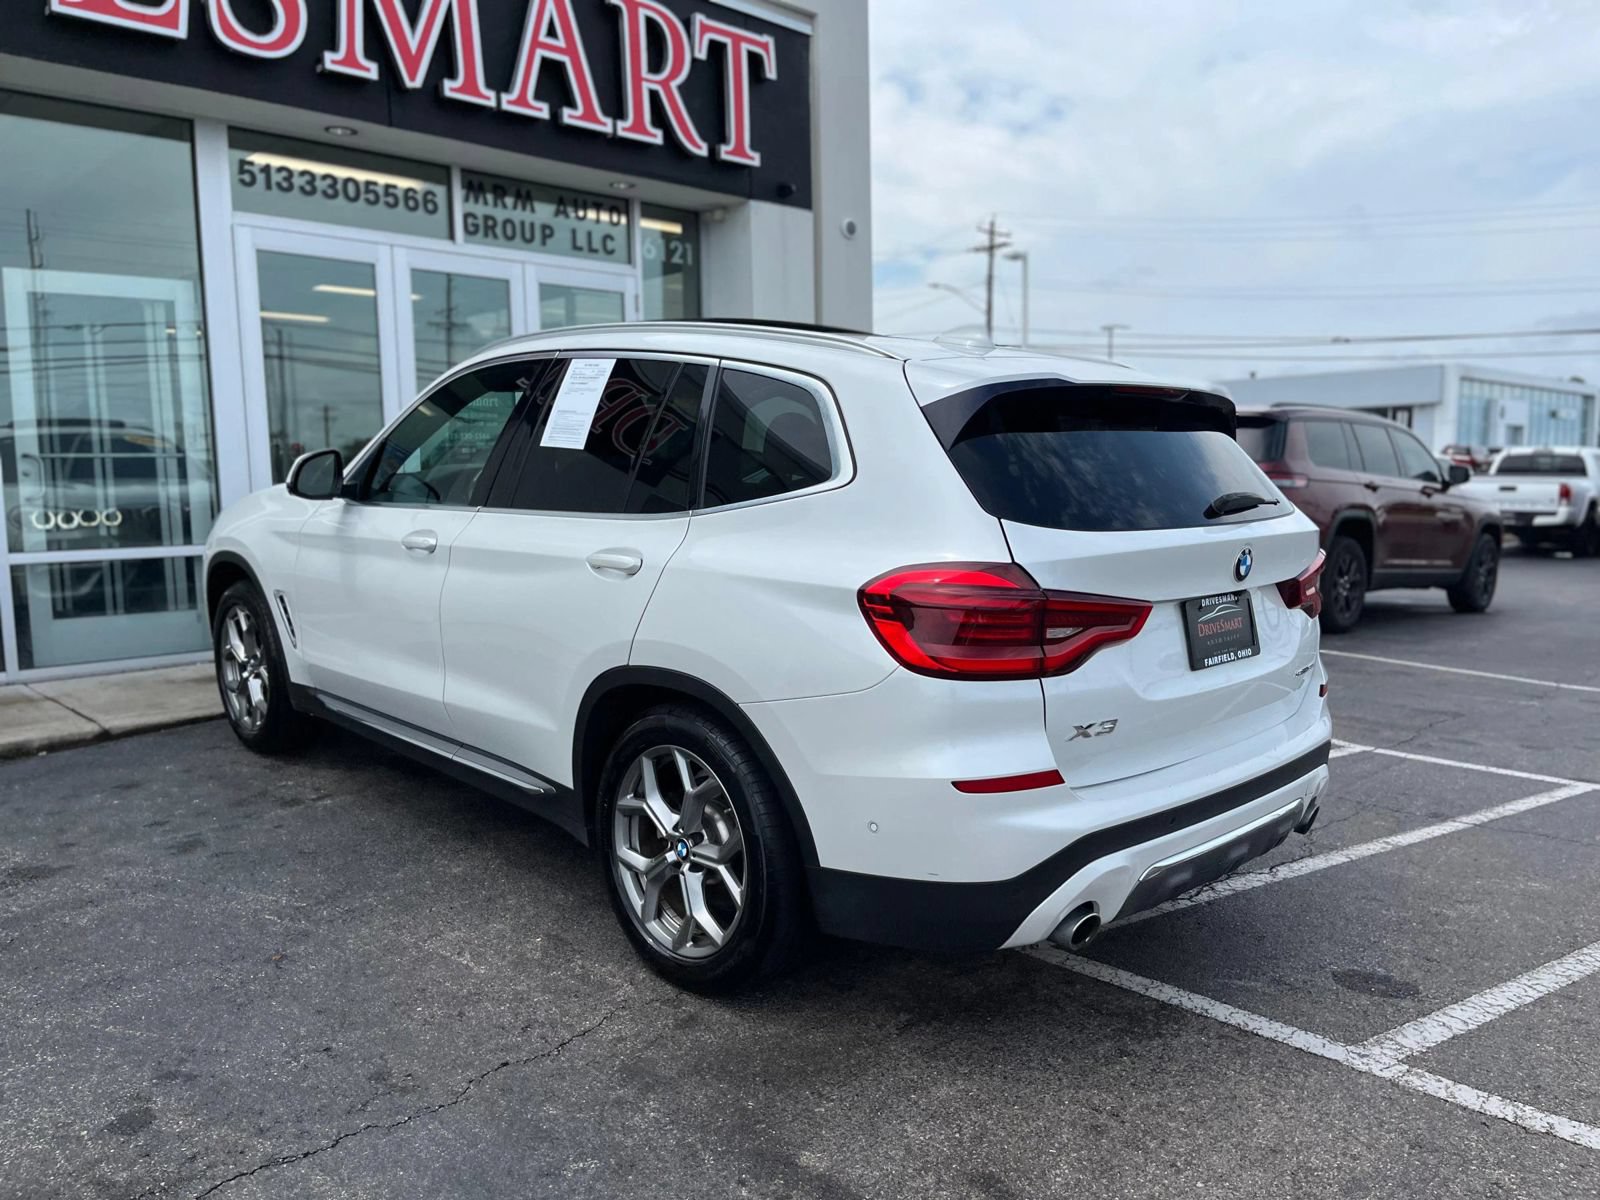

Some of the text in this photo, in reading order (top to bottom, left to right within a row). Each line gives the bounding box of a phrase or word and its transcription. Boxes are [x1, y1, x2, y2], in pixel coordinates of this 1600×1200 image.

[238, 158, 439, 215] 5133305566
[464, 180, 622, 227] MRM AUTO
[463, 212, 616, 256] GROUP LLC
[1204, 651, 1237, 667] FAIRFIELD,
[1237, 647, 1252, 658] OHIO
[1065, 718, 1119, 742] X3
